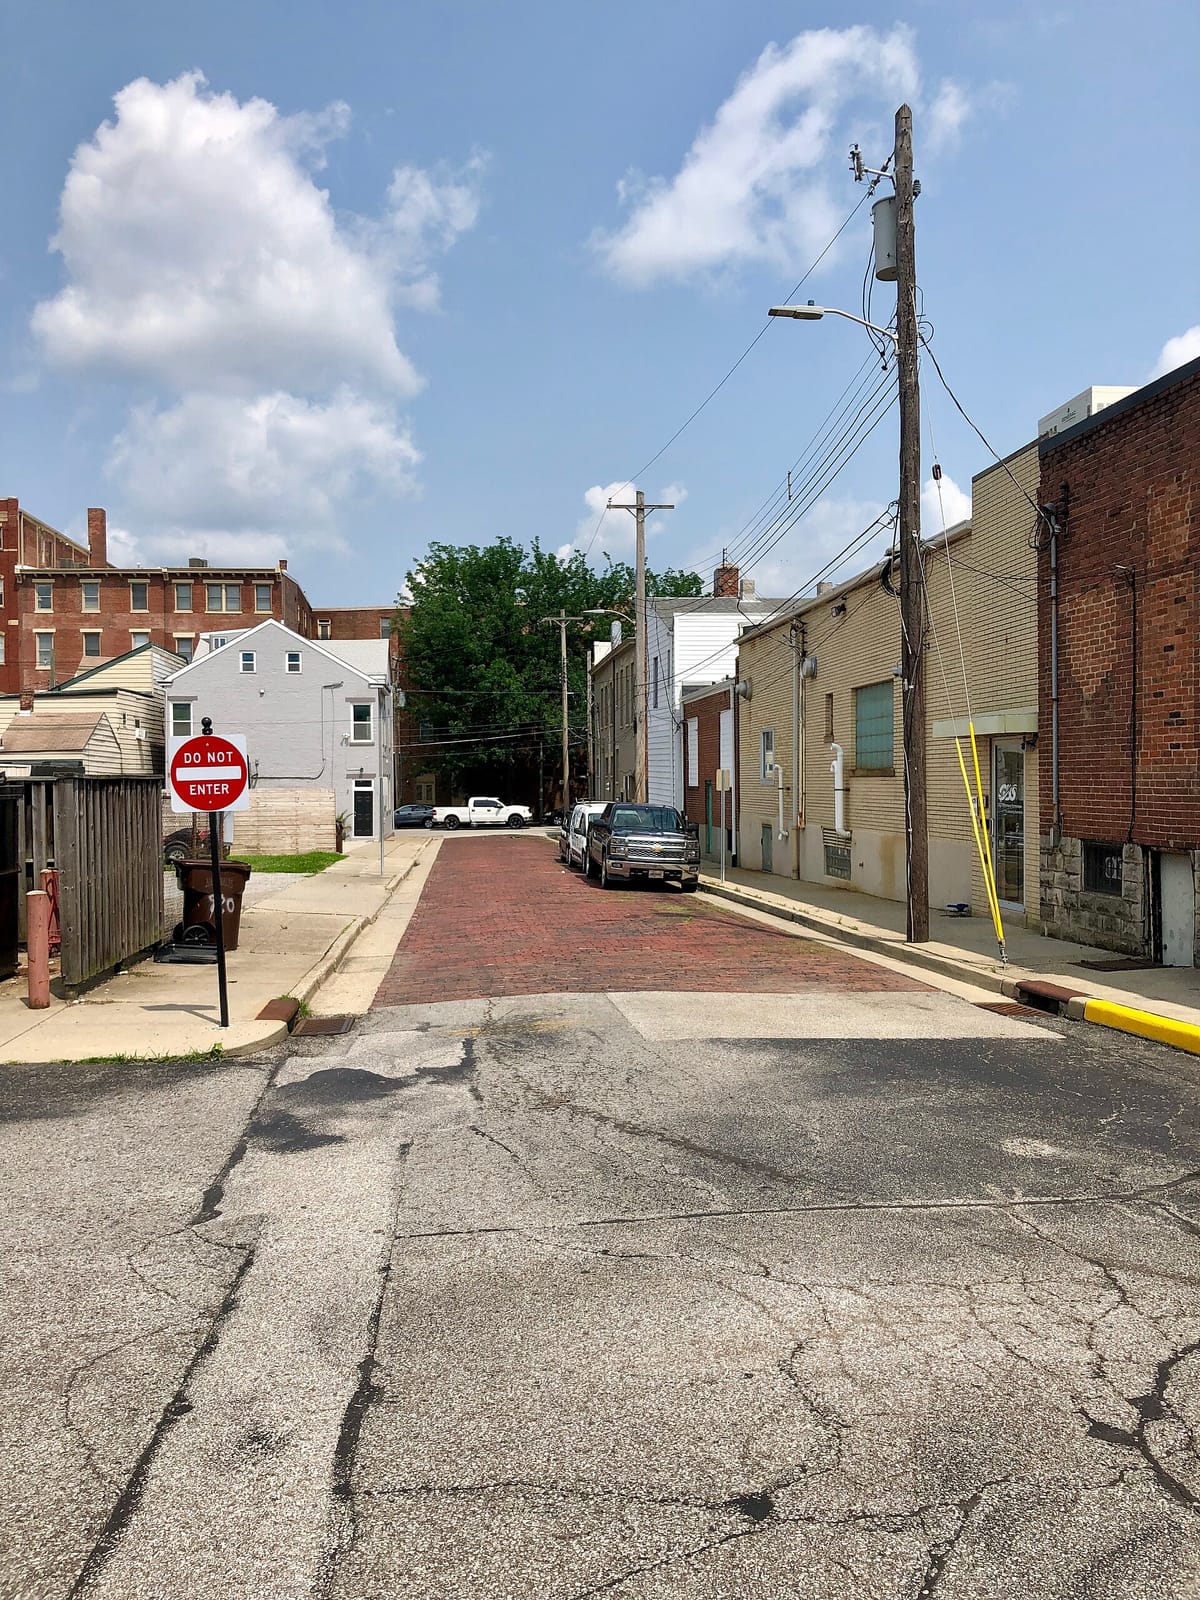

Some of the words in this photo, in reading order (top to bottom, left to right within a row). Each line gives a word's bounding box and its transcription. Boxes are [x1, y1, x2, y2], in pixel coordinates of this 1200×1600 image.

[184, 752, 201, 764] DO
[207, 751, 233, 763] NOT
[189, 783, 230, 796] ENTER
